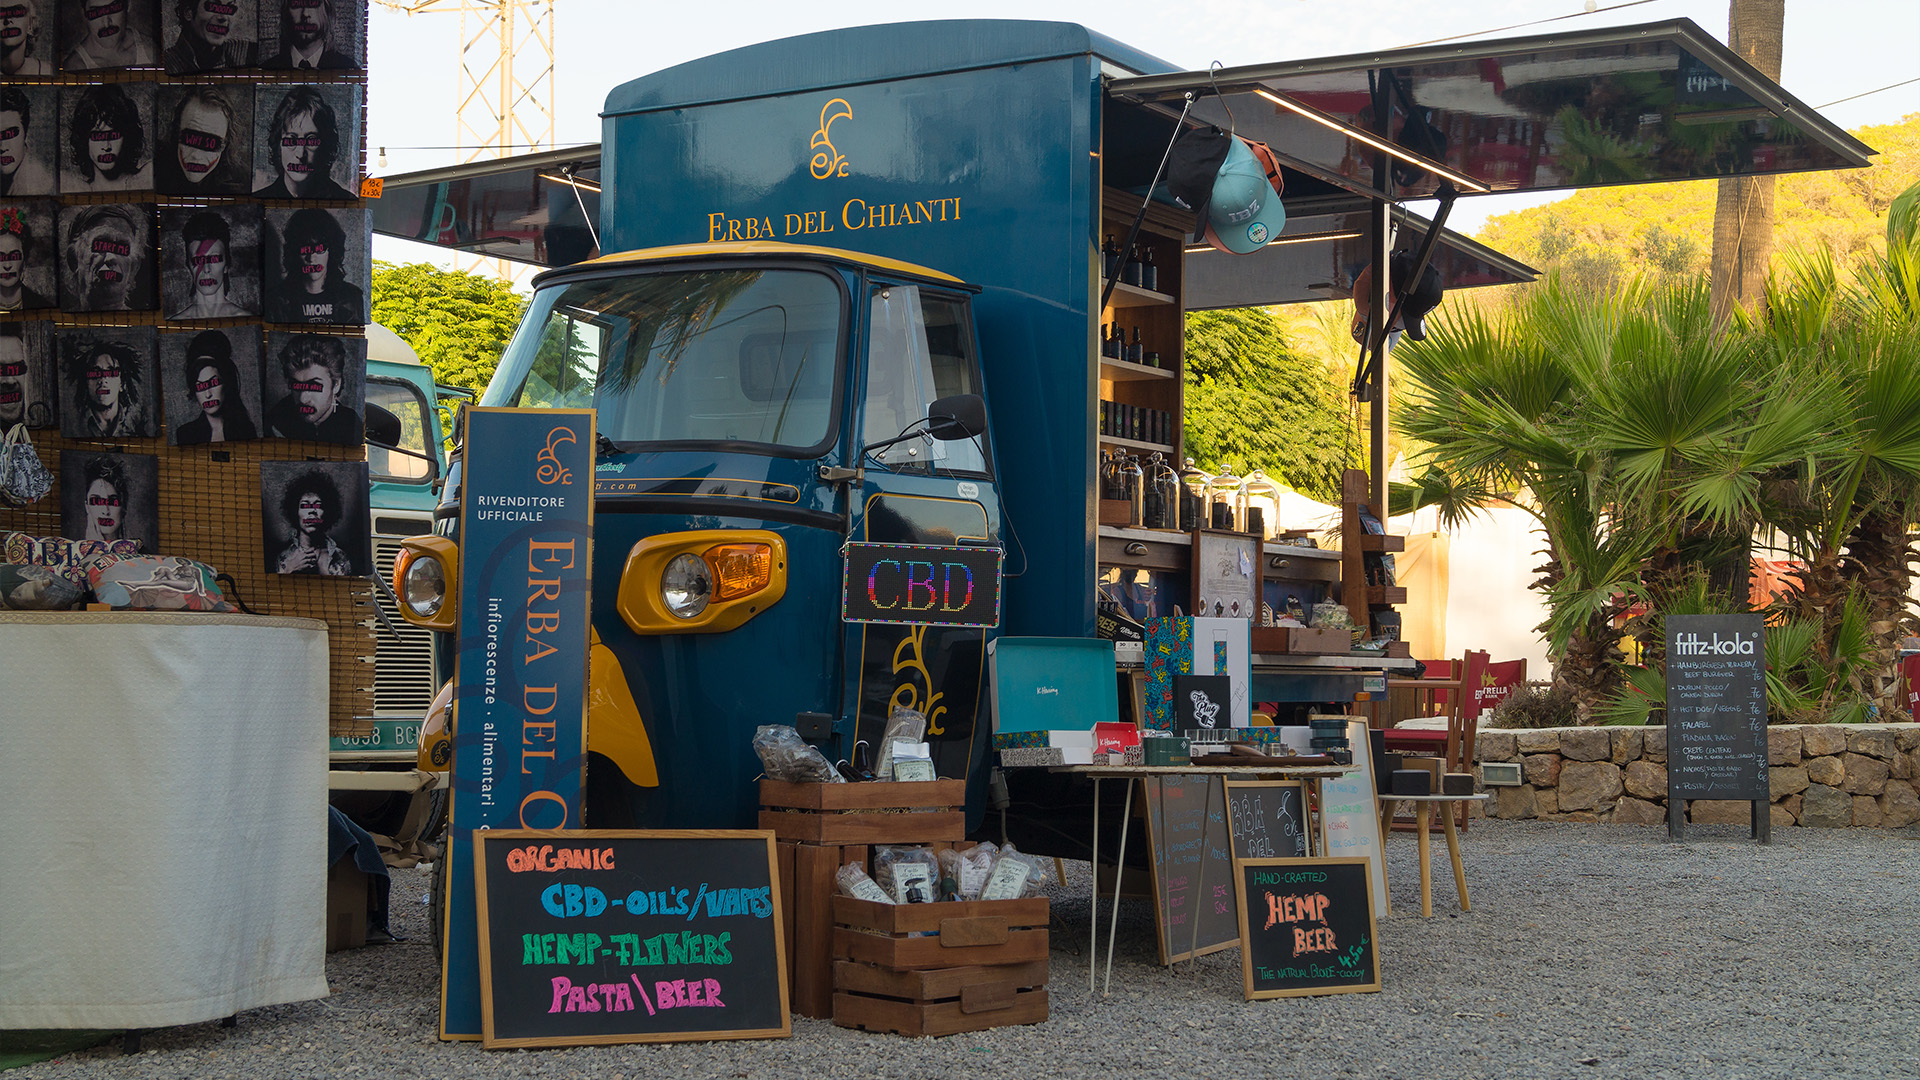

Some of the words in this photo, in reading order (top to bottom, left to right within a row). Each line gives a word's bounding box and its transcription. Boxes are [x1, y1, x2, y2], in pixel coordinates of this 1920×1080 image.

[707, 212, 775, 243] ERBA
[785, 211, 834, 236] DEL
[842, 197, 962, 230] CHIANTI
[478, 495, 565, 508] RIVENDITORE
[478, 510, 543, 522] UFFICIALE
[525, 538, 575, 666] ERBA
[868, 558, 974, 612] CBD
[485, 598, 502, 705] infiorescenze
[521, 683, 558, 775] DEL
[482, 721, 498, 806] alimentari
[506, 845, 616, 873] ORGANIC
[1254, 871, 1328, 886] HAND-CRAFTED
[1265, 891, 1331, 928] HEMP
[522, 930, 733, 966] HEMP-FLOWERS
[1293, 927, 1338, 955] BEER
[1257, 966, 1275, 980] THE
